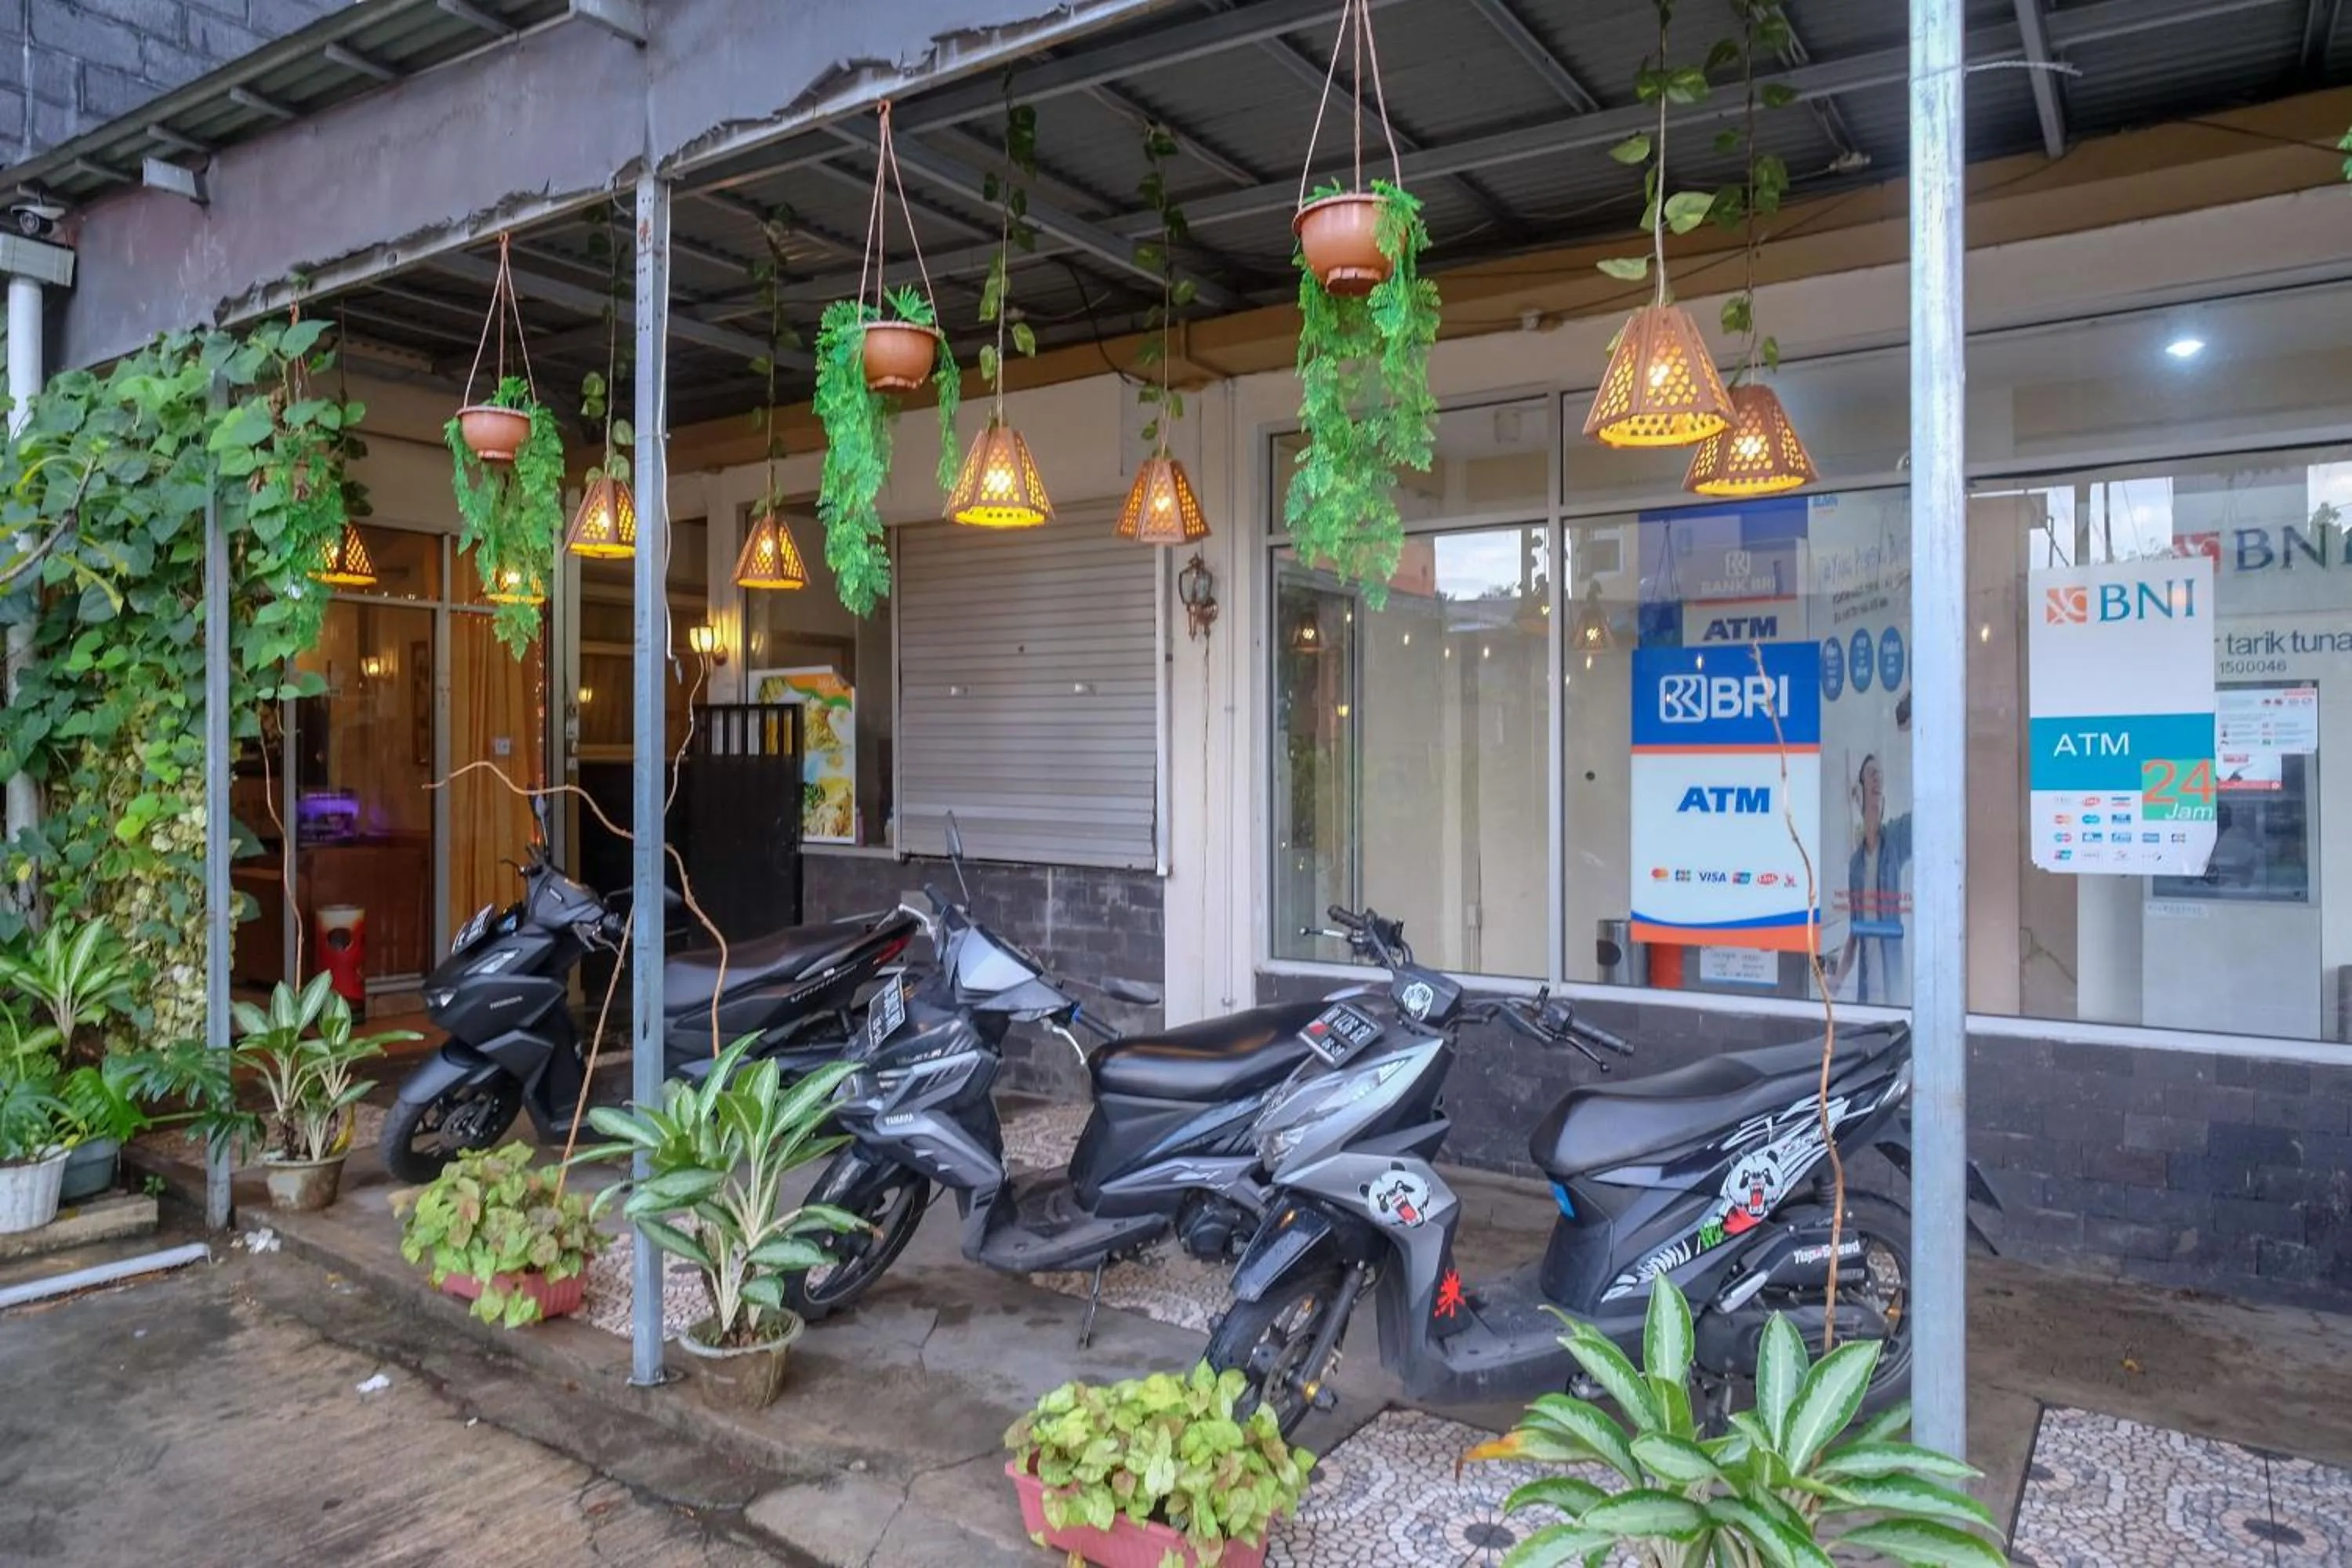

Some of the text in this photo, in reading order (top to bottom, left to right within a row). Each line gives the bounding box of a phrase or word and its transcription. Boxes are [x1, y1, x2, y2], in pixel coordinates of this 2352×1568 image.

[1701, 575, 1777, 595] BANK BRI
[2099, 578, 2194, 622] BNI
[1703, 615, 1777, 641] ATM
[2226, 630, 2285, 655] tarik
[1710, 675, 1789, 719] BRI
[2053, 731, 2130, 757] ATM
[2142, 757, 2216, 804] 24
[1677, 786, 1770, 812] ATM
[2164, 802, 2213, 821] Jam
[1698, 871, 1727, 883] VISA
